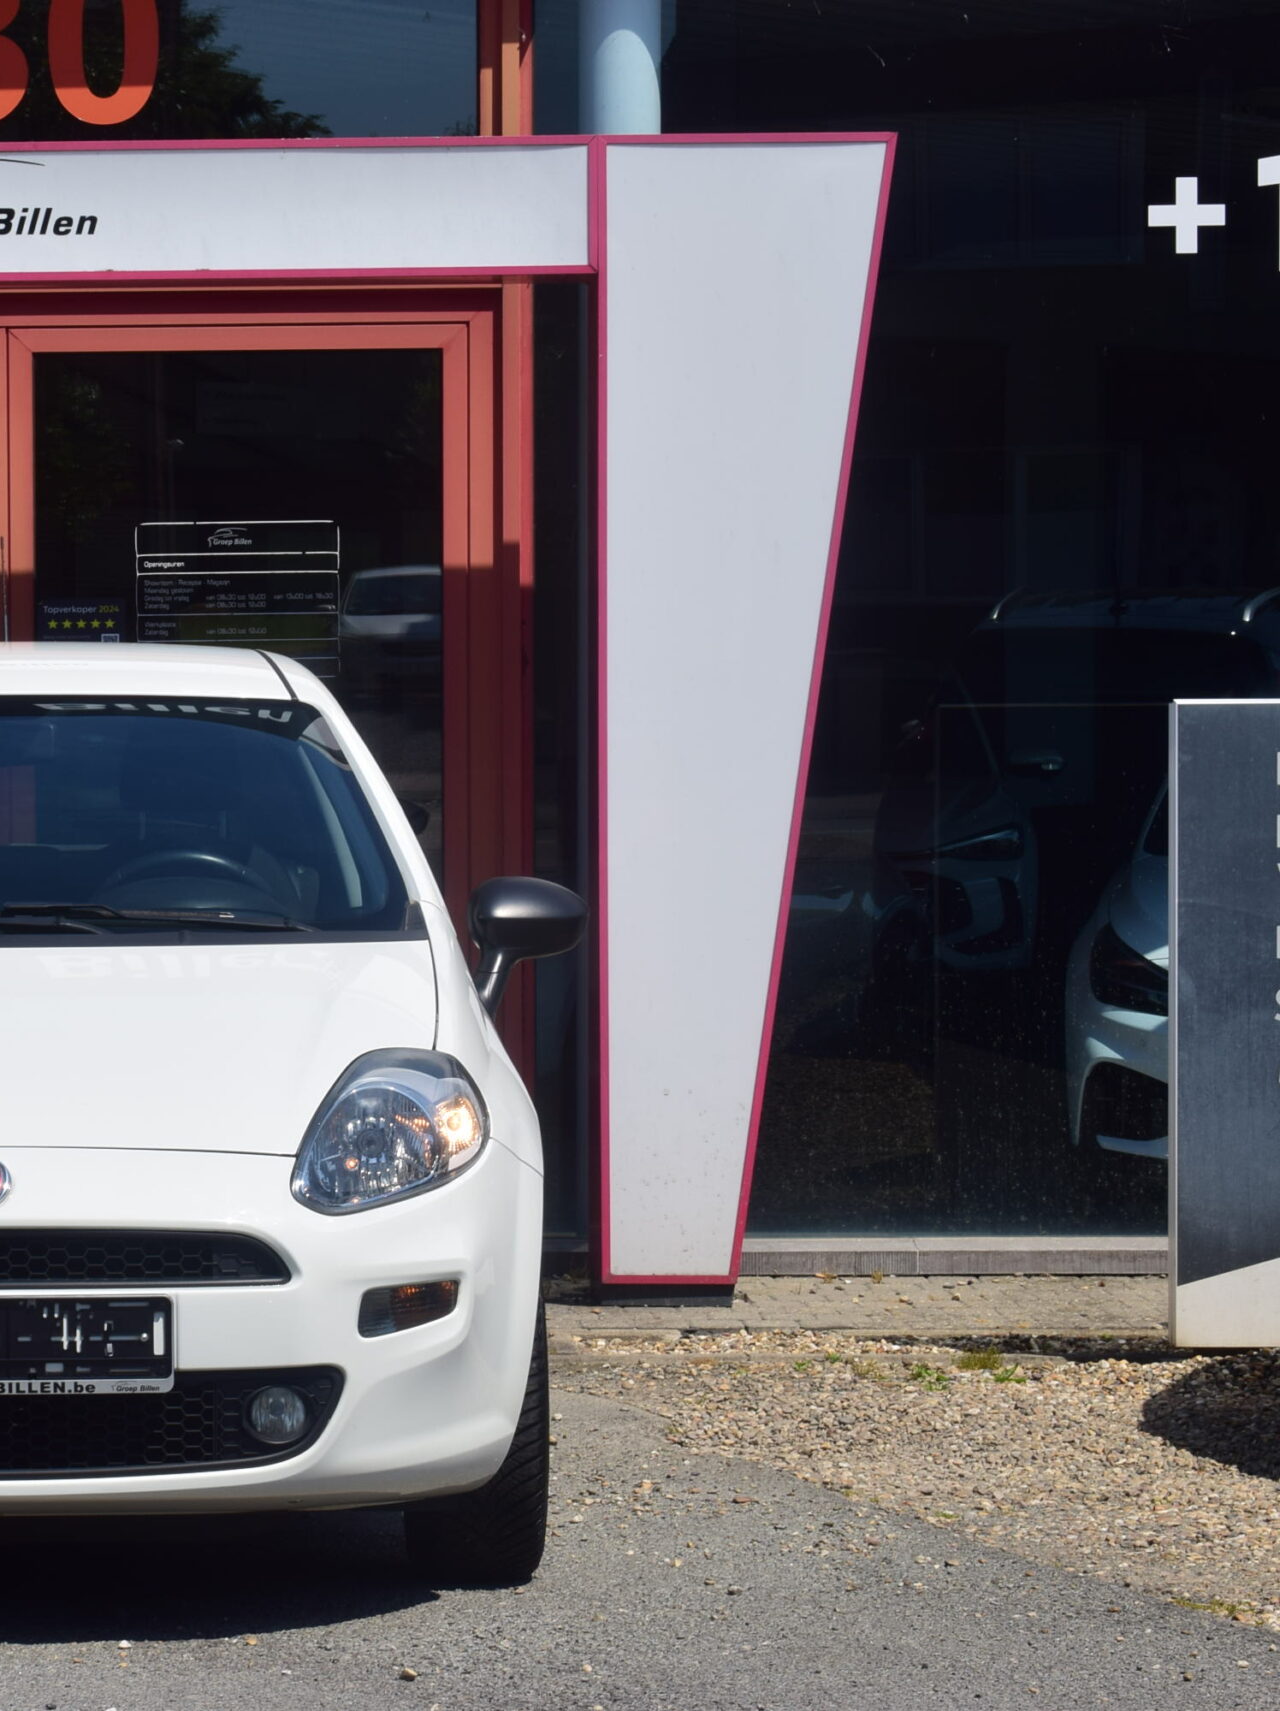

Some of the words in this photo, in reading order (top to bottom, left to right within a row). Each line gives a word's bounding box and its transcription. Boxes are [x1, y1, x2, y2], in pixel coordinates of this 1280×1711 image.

[213, 538, 233, 547] Groep
[234, 537, 252, 546] Billen
[42, 606, 97, 616] Topverkoper
[98, 605, 120, 614] 2024
[116, 1385, 137, 1393] Groep
[140, 1384, 160, 1392] Billen
